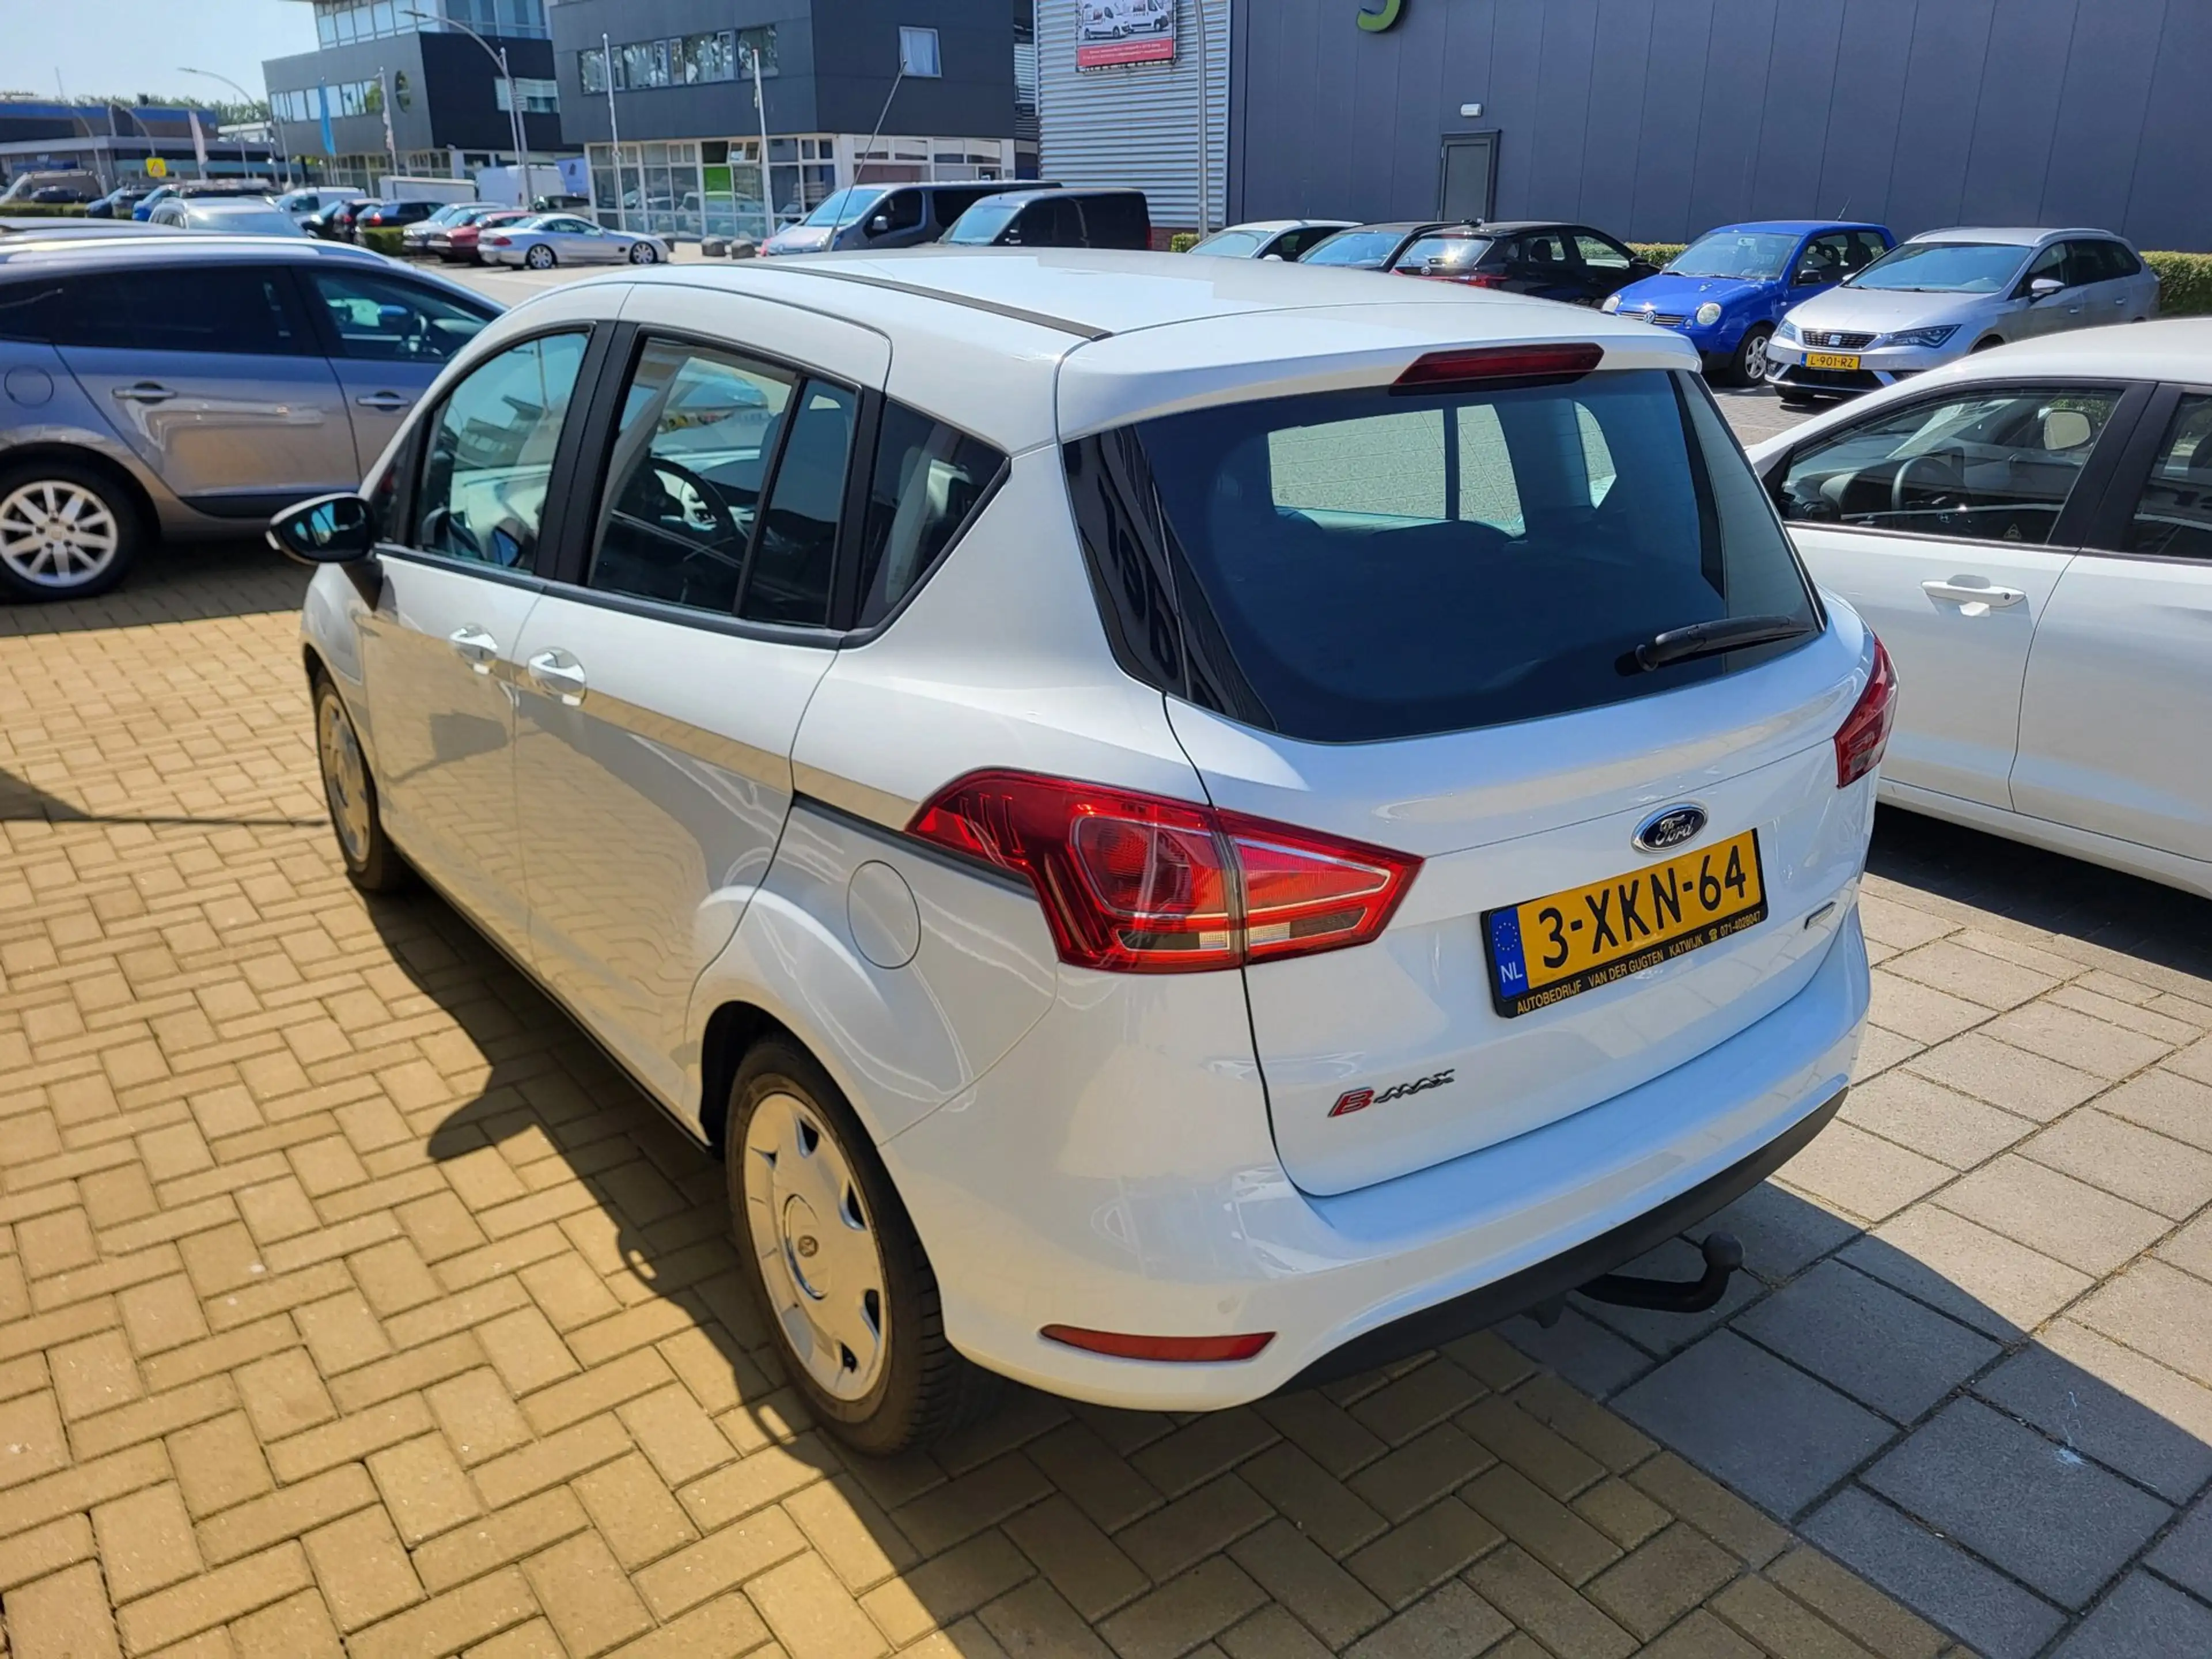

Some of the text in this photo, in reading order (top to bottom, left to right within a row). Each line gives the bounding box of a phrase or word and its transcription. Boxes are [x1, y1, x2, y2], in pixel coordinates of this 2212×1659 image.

[1810, 356, 1854, 368] L-901-RZ
[1655, 814, 1695, 846] Ford
[1538, 844, 1747, 969] 3-XKN-64
[1501, 961, 1523, 983] NL
[1517, 979, 1583, 1015] AUTOBEDRIJF
[1588, 973, 1607, 987] VAN
[1608, 964, 1628, 983] DER
[1628, 949, 1664, 974] GUGTEN
[1669, 933, 1705, 957] KATWIJK
